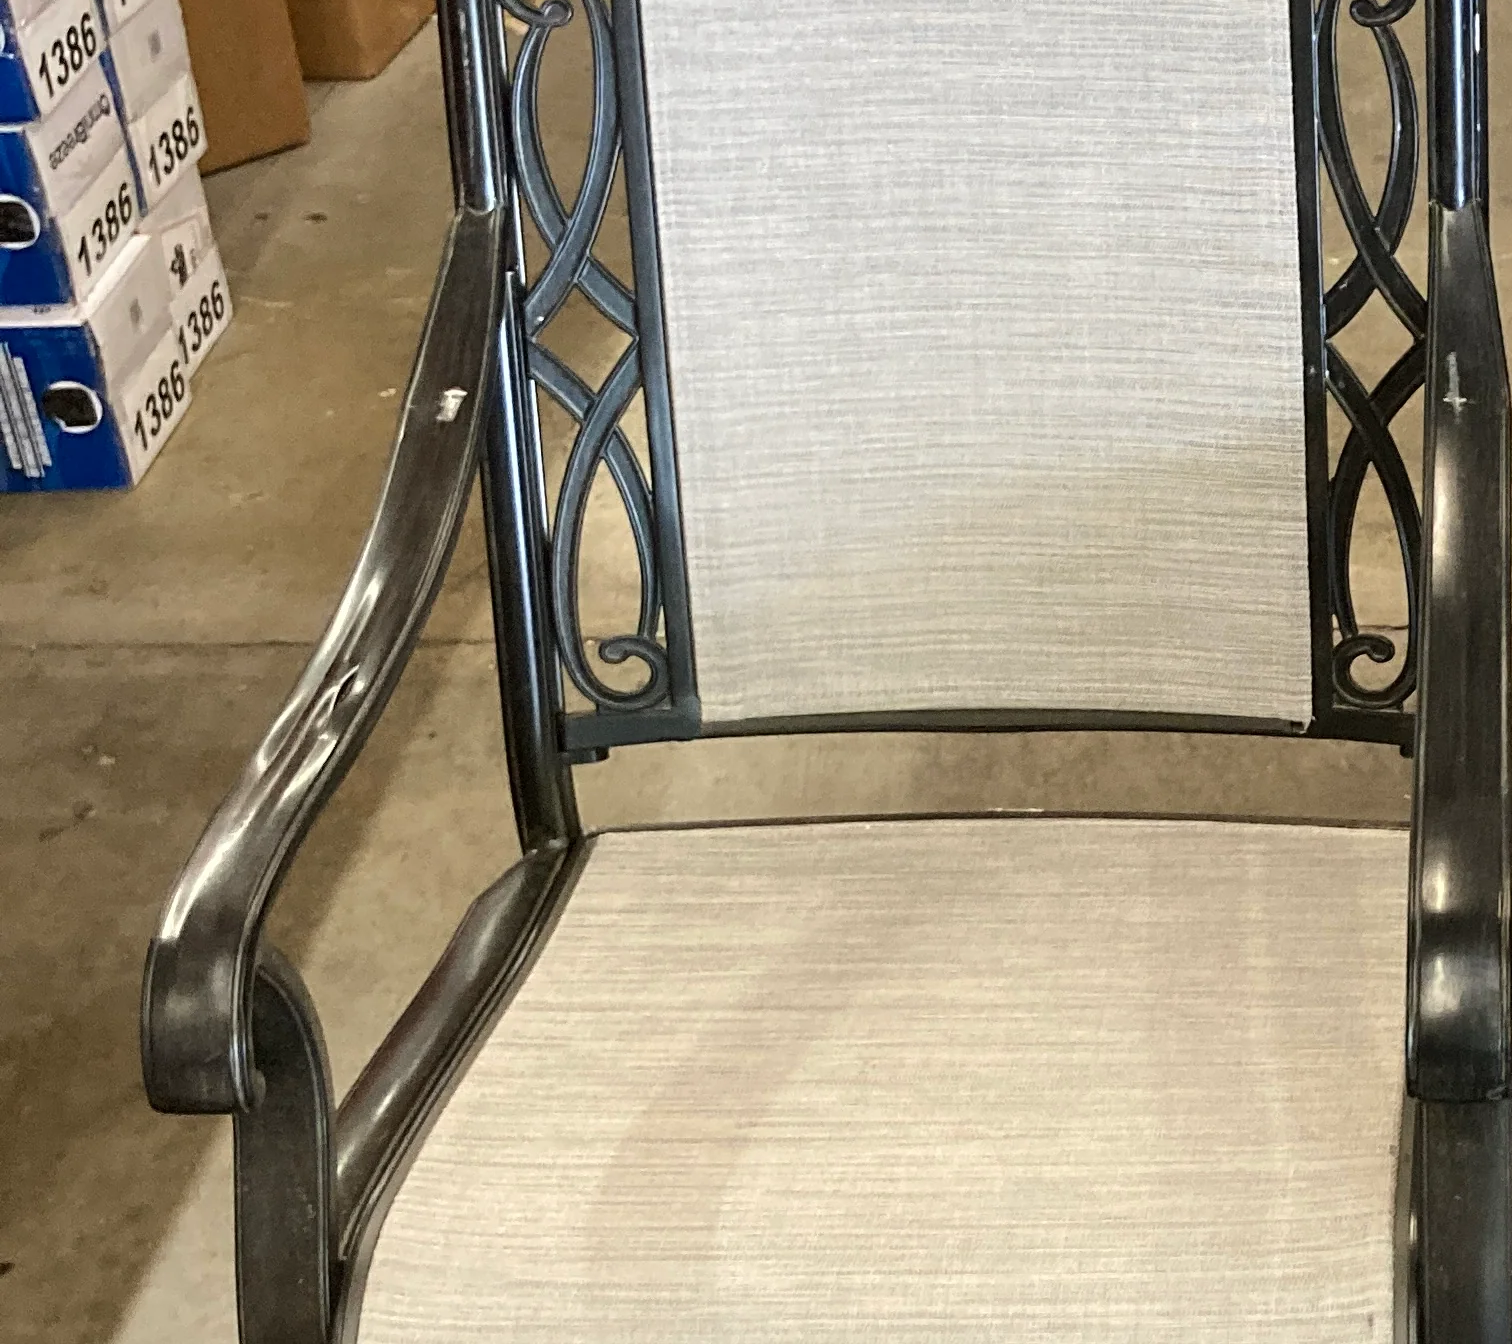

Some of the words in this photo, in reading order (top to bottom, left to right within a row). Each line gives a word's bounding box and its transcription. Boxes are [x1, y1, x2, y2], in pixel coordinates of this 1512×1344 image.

[38, 12, 98, 99] 1386
[148, 106, 200, 187] 1386
[77, 181, 133, 277] 1386
[178, 279, 225, 365] 1386
[134, 359, 186, 451] 1386
